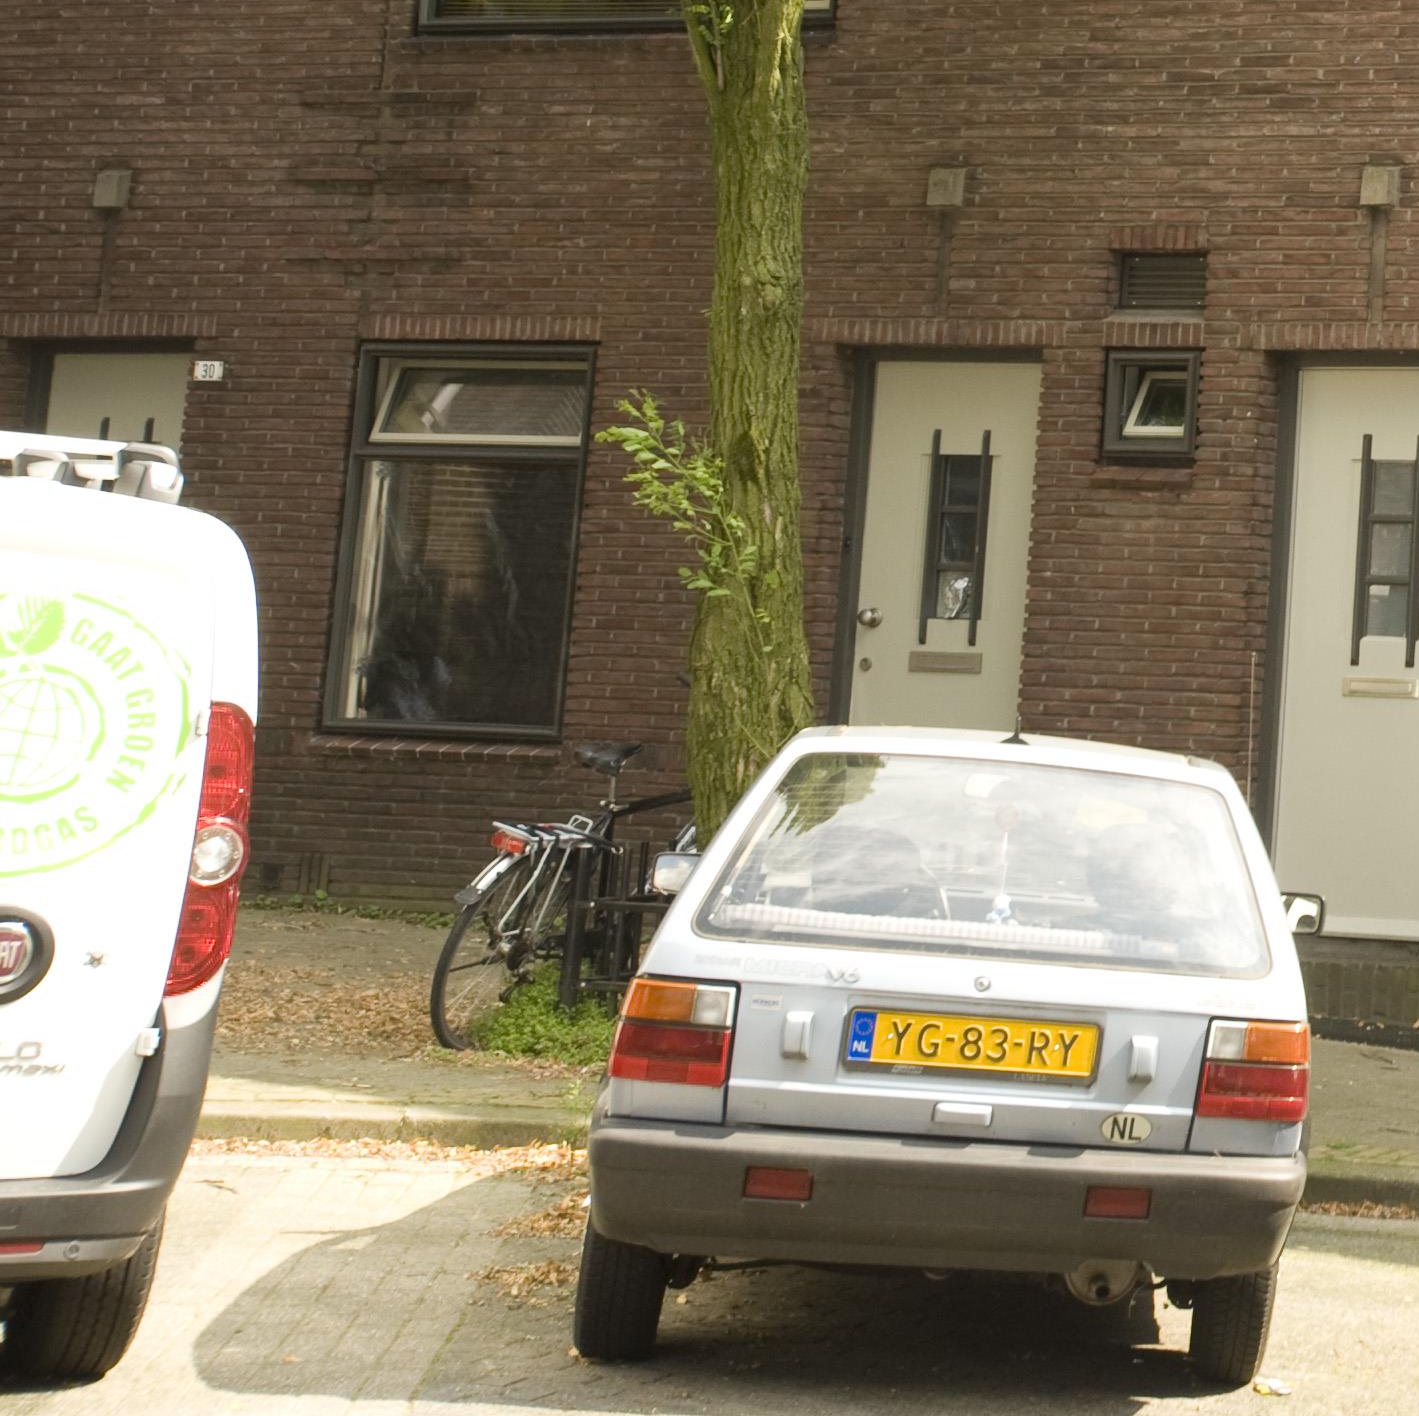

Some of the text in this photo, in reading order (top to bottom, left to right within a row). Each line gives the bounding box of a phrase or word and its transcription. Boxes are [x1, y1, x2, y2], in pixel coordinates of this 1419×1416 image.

[70, 617, 156, 792] GAAT GROEN
[852, 1038, 870, 1053] NL
[892, 1019, 1079, 1067] YG-83-RY
[1110, 1117, 1141, 1141] NL
